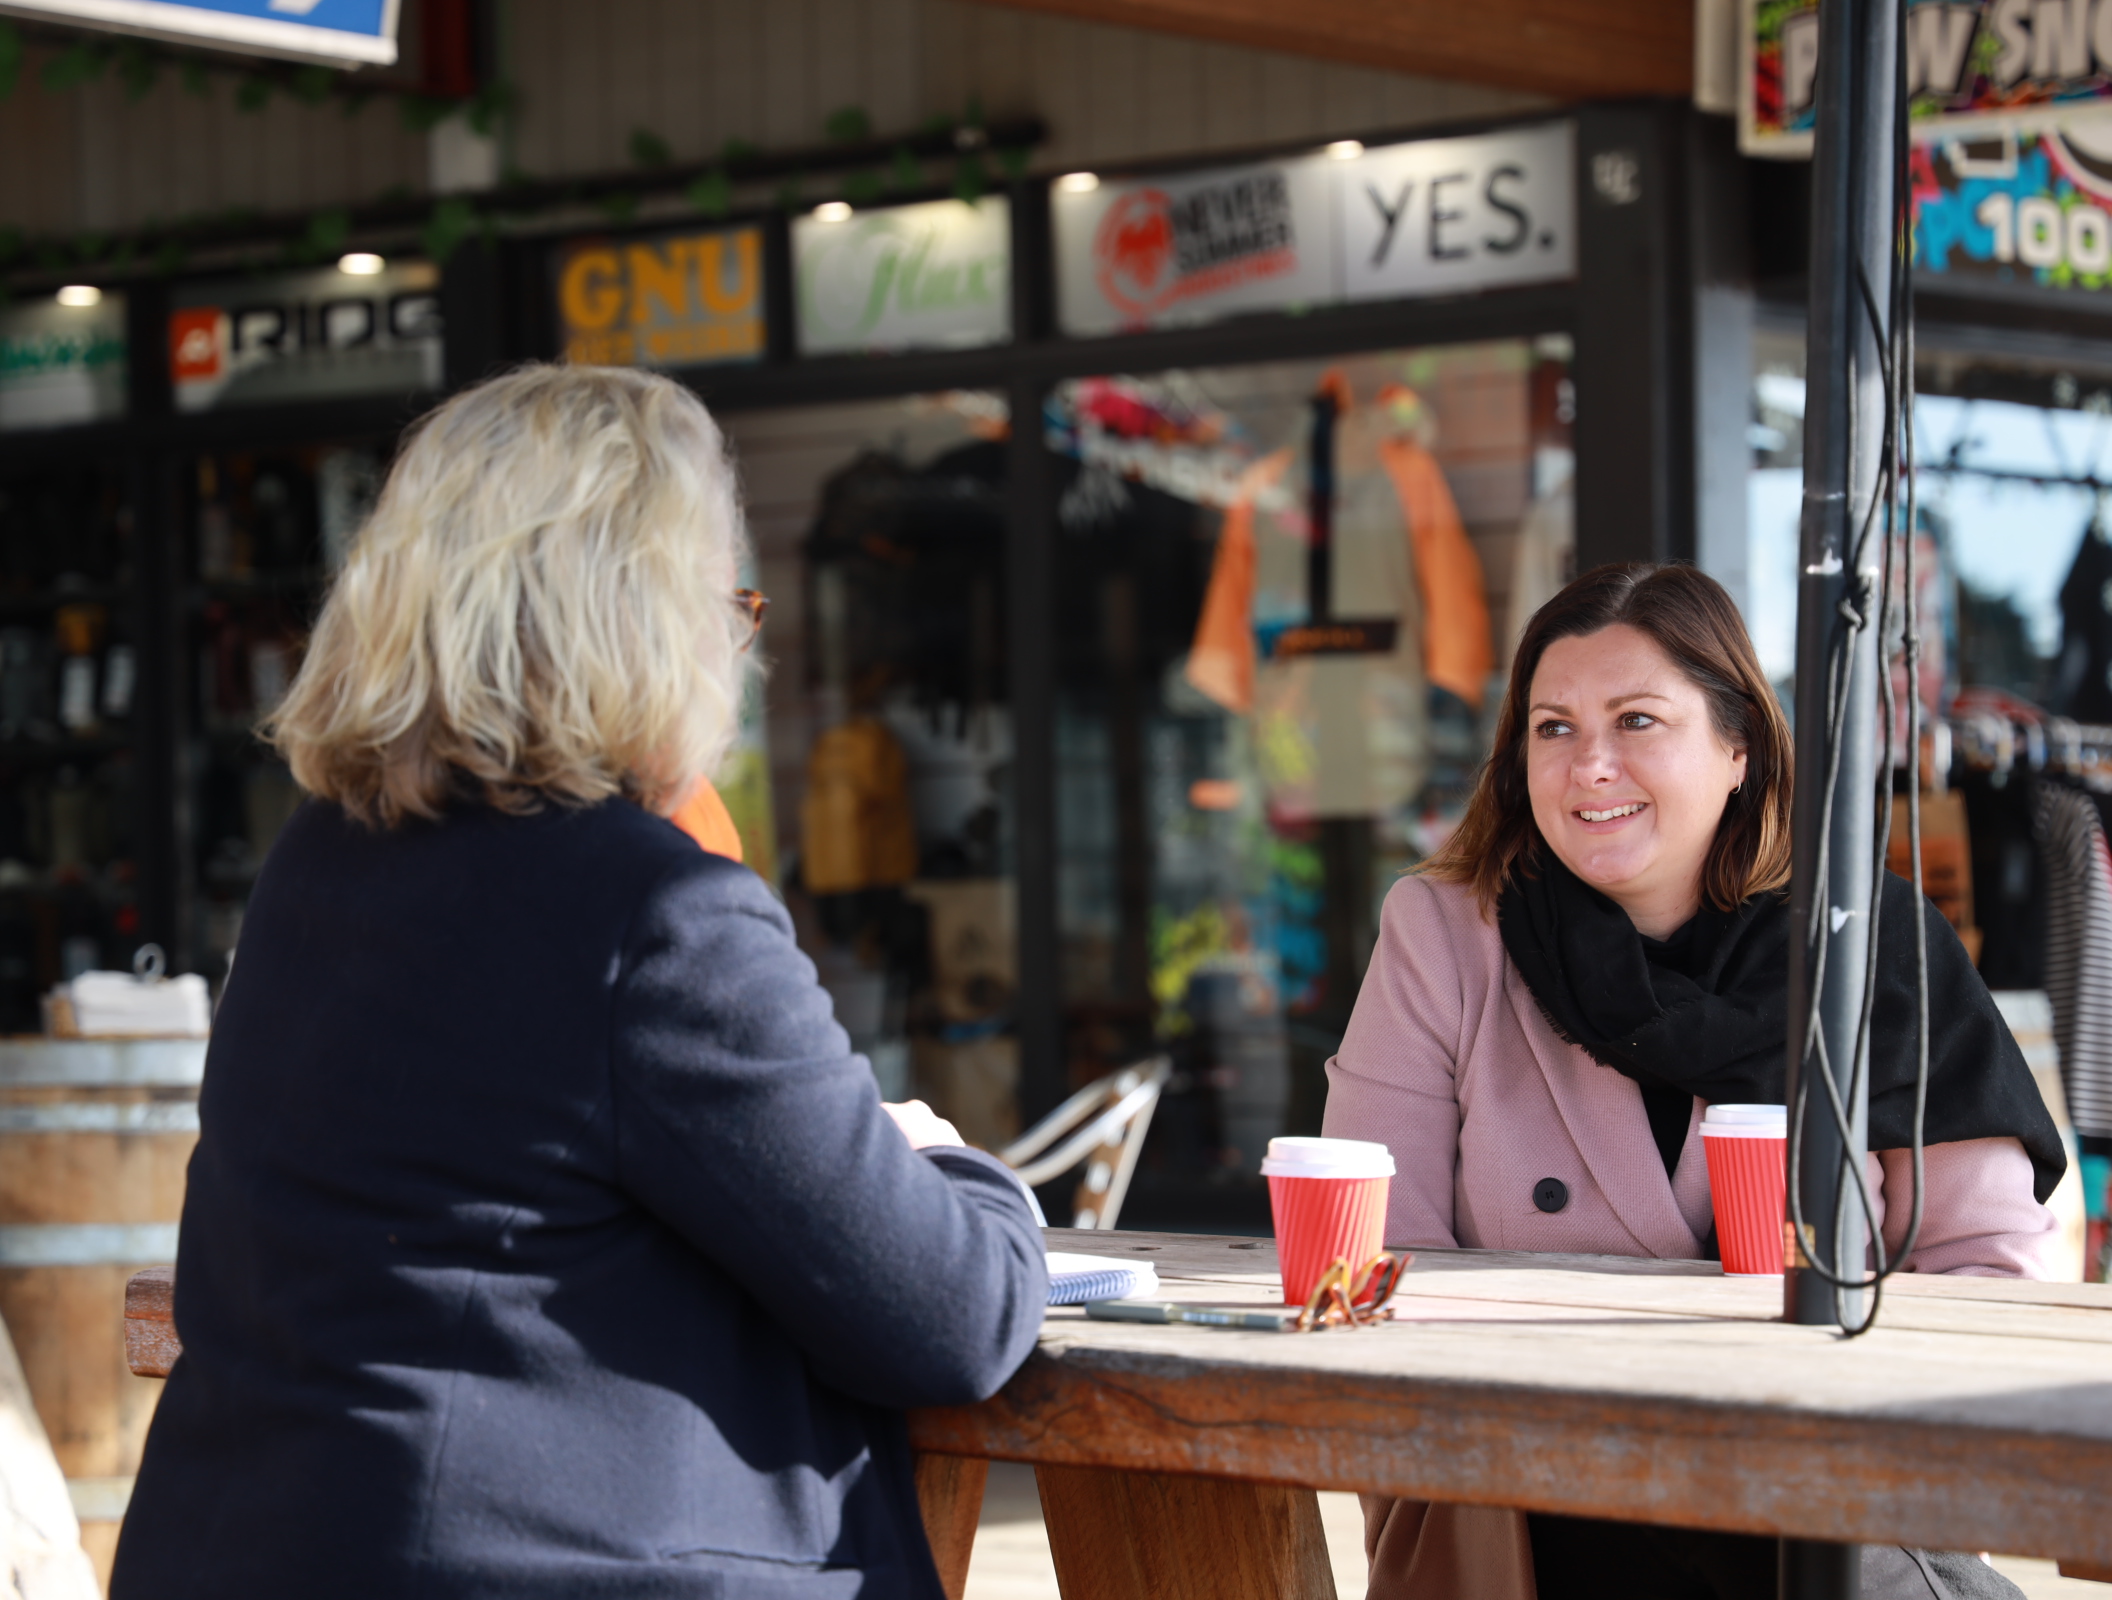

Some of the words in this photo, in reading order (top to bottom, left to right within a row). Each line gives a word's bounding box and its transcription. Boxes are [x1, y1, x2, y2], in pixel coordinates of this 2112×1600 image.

[1168, 170, 1289, 240] NEVER
[1364, 162, 1556, 268] YES.
[559, 228, 764, 332] GNU
[232, 294, 443, 354] RIDE
